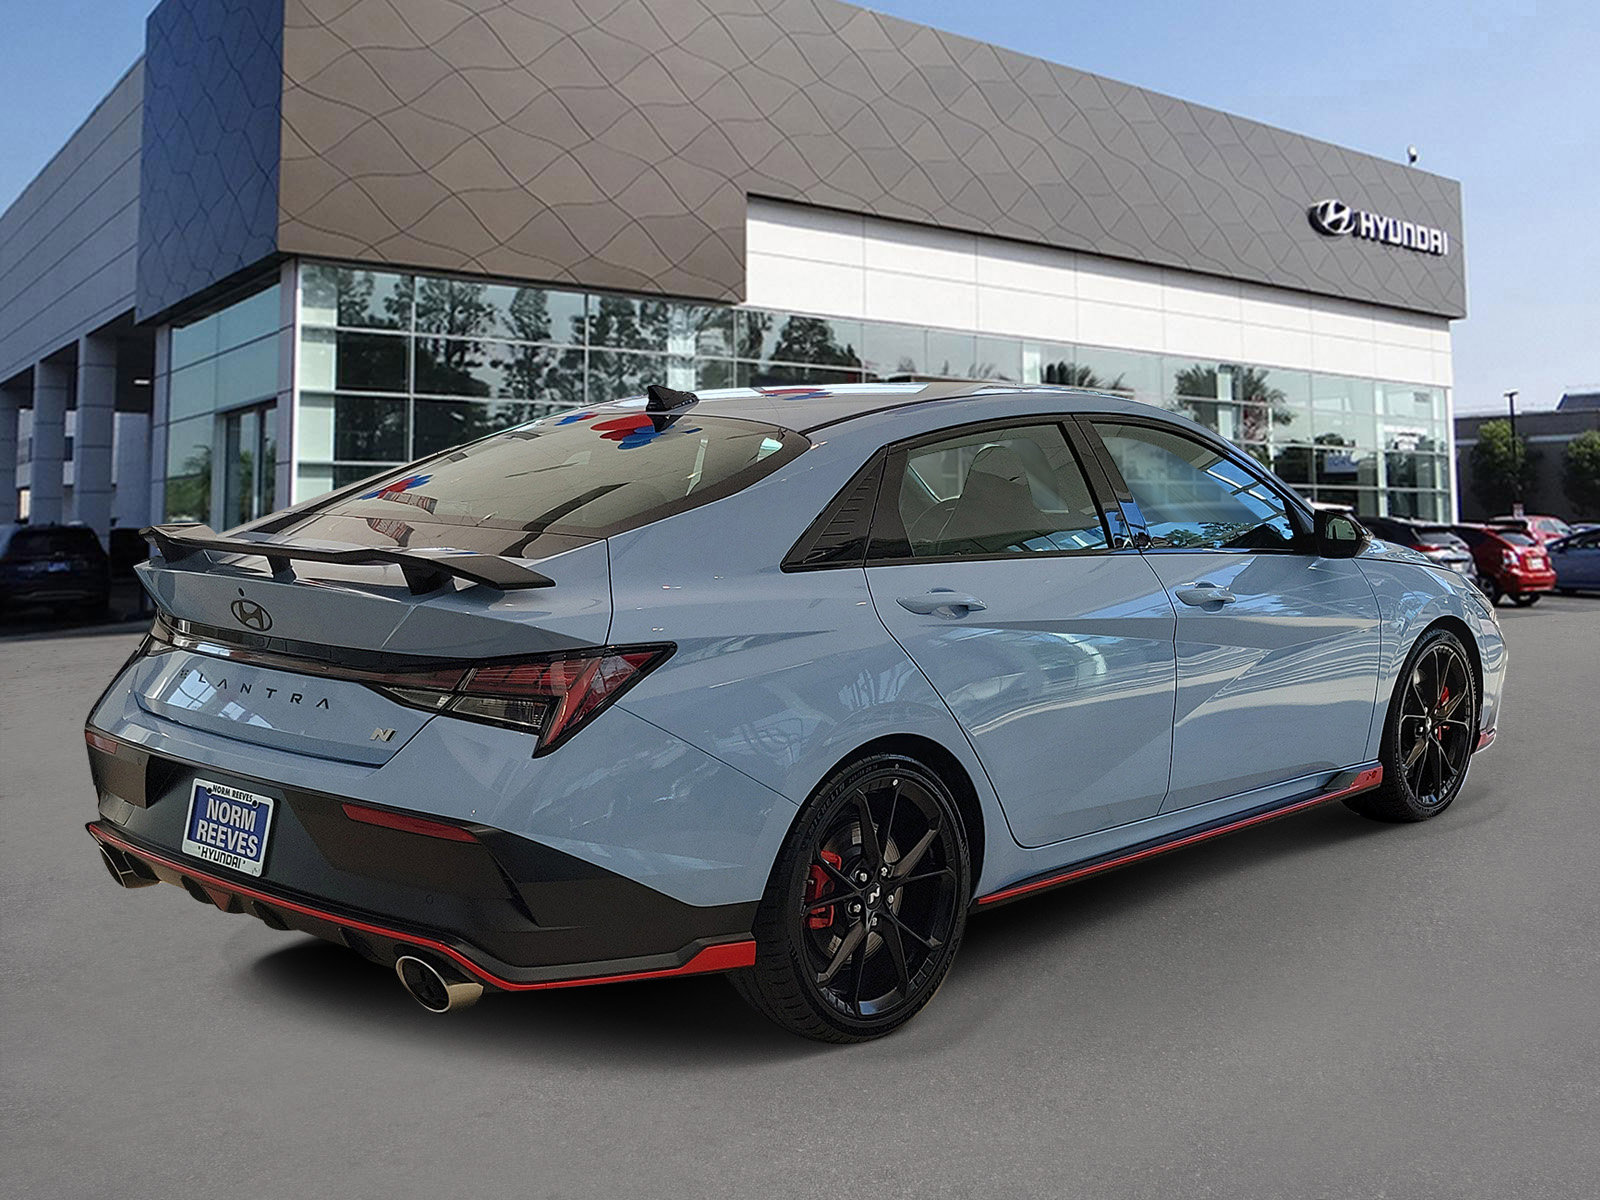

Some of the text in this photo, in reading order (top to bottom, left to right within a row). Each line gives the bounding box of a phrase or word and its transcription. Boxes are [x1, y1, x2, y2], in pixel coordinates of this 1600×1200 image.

[1360, 210, 1449, 255] HYUNDAI
[369, 727, 398, 743] N
[212, 784, 253, 803] NORM REEVES
[206, 798, 257, 832] NORM
[196, 819, 259, 858] REEVES
[200, 846, 242, 869] HYUNDAI
